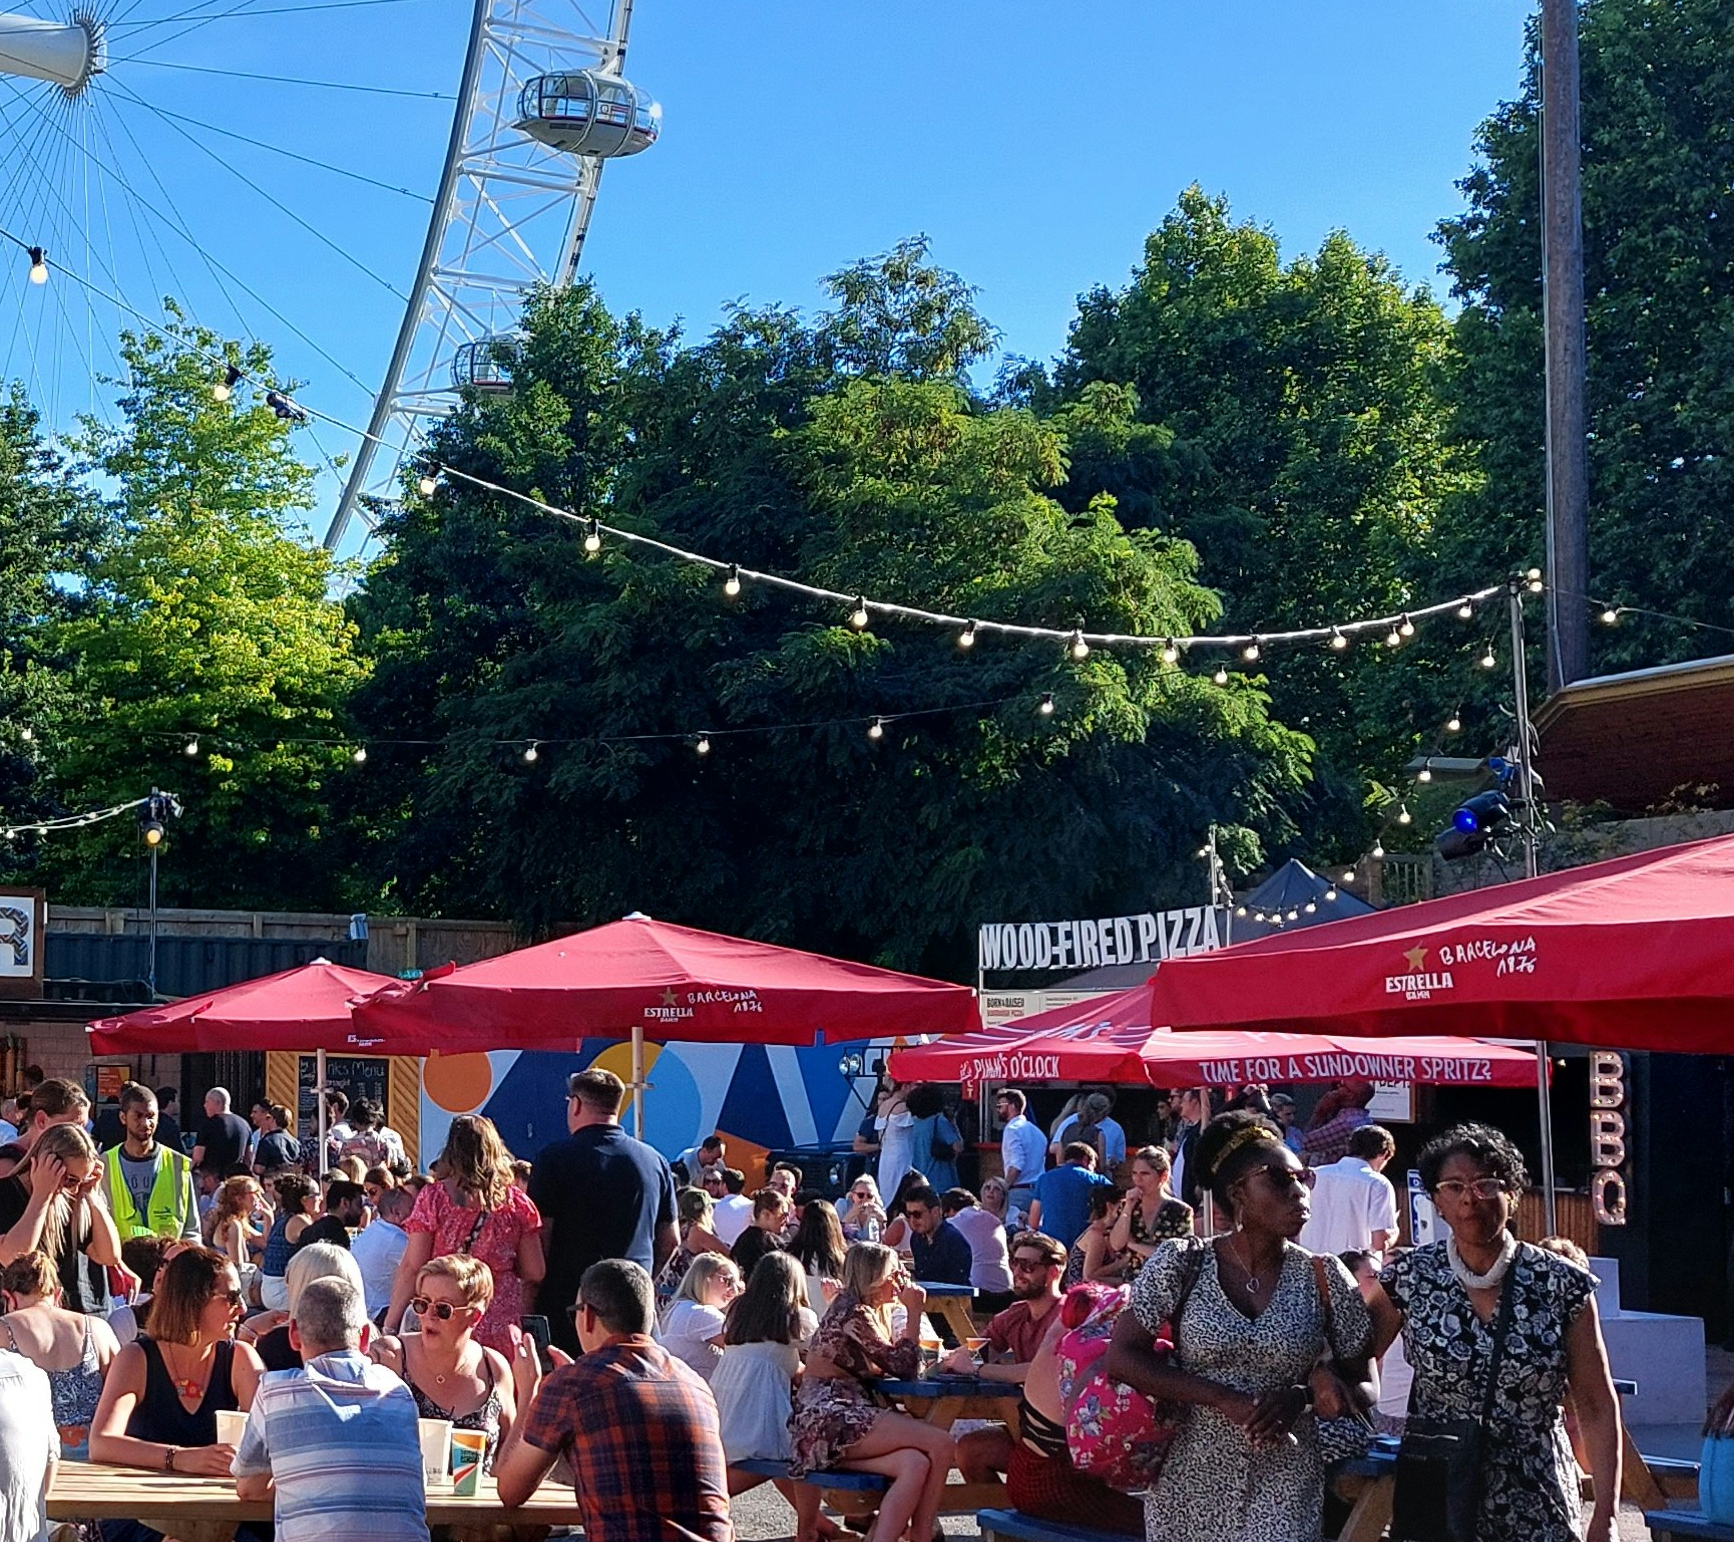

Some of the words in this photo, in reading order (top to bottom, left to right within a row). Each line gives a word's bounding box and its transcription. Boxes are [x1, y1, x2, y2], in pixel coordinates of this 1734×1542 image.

[981, 919, 1135, 969] WOOD-FIRED
[1138, 905, 1221, 963] PIZZA
[1439, 935, 1537, 966] BARCELONA
[1497, 956, 1537, 978] 1876
[1385, 972, 1454, 993] ESTRELLA
[687, 989, 757, 1004] BARCELONA
[644, 1007, 694, 1017] ESTRELLA
[1010, 1051, 1060, 1078] O'CLOCK
[1199, 1061, 1241, 1082] TIME
[1245, 1059, 1284, 1080] FOR
[1288, 1057, 1304, 1078] A
[1307, 1054, 1416, 1080] SUNDOWNER
[1422, 1058, 1492, 1081] SPRITZ?
[1589, 1051, 1626, 1226] BBQ
